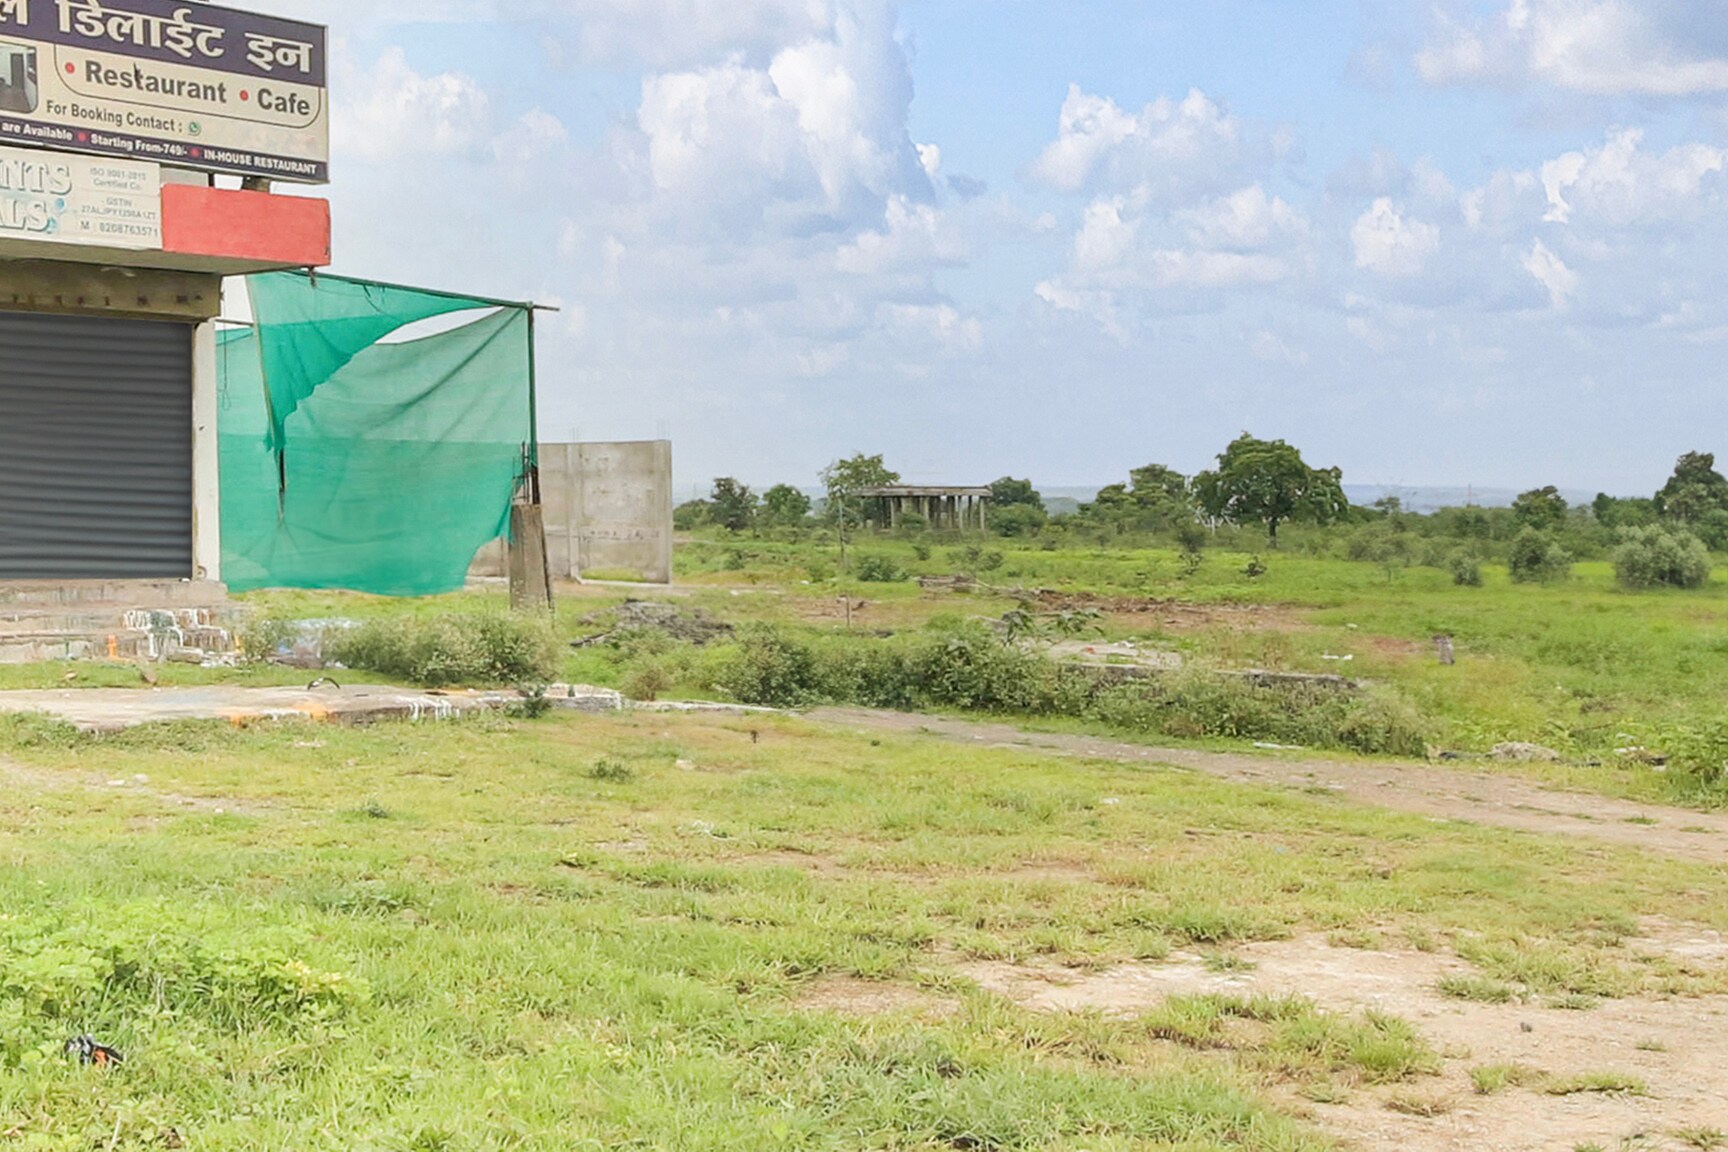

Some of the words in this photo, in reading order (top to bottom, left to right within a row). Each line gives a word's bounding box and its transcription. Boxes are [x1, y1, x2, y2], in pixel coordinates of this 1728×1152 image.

[244, 31, 314, 74] इन
[85, 59, 228, 105] Restaurant
[257, 87, 312, 116] Cafe
[46, 100, 68, 116] For
[71, 103, 123, 127] Booking
[126, 112, 176, 133] Contact
[2, 122, 21, 134] are
[23, 123, 73, 143] Available
[90, 133, 133, 151] Starting
[204, 149, 253, 167] IN-HOUSE
[254, 155, 318, 175] RESTAURANT
